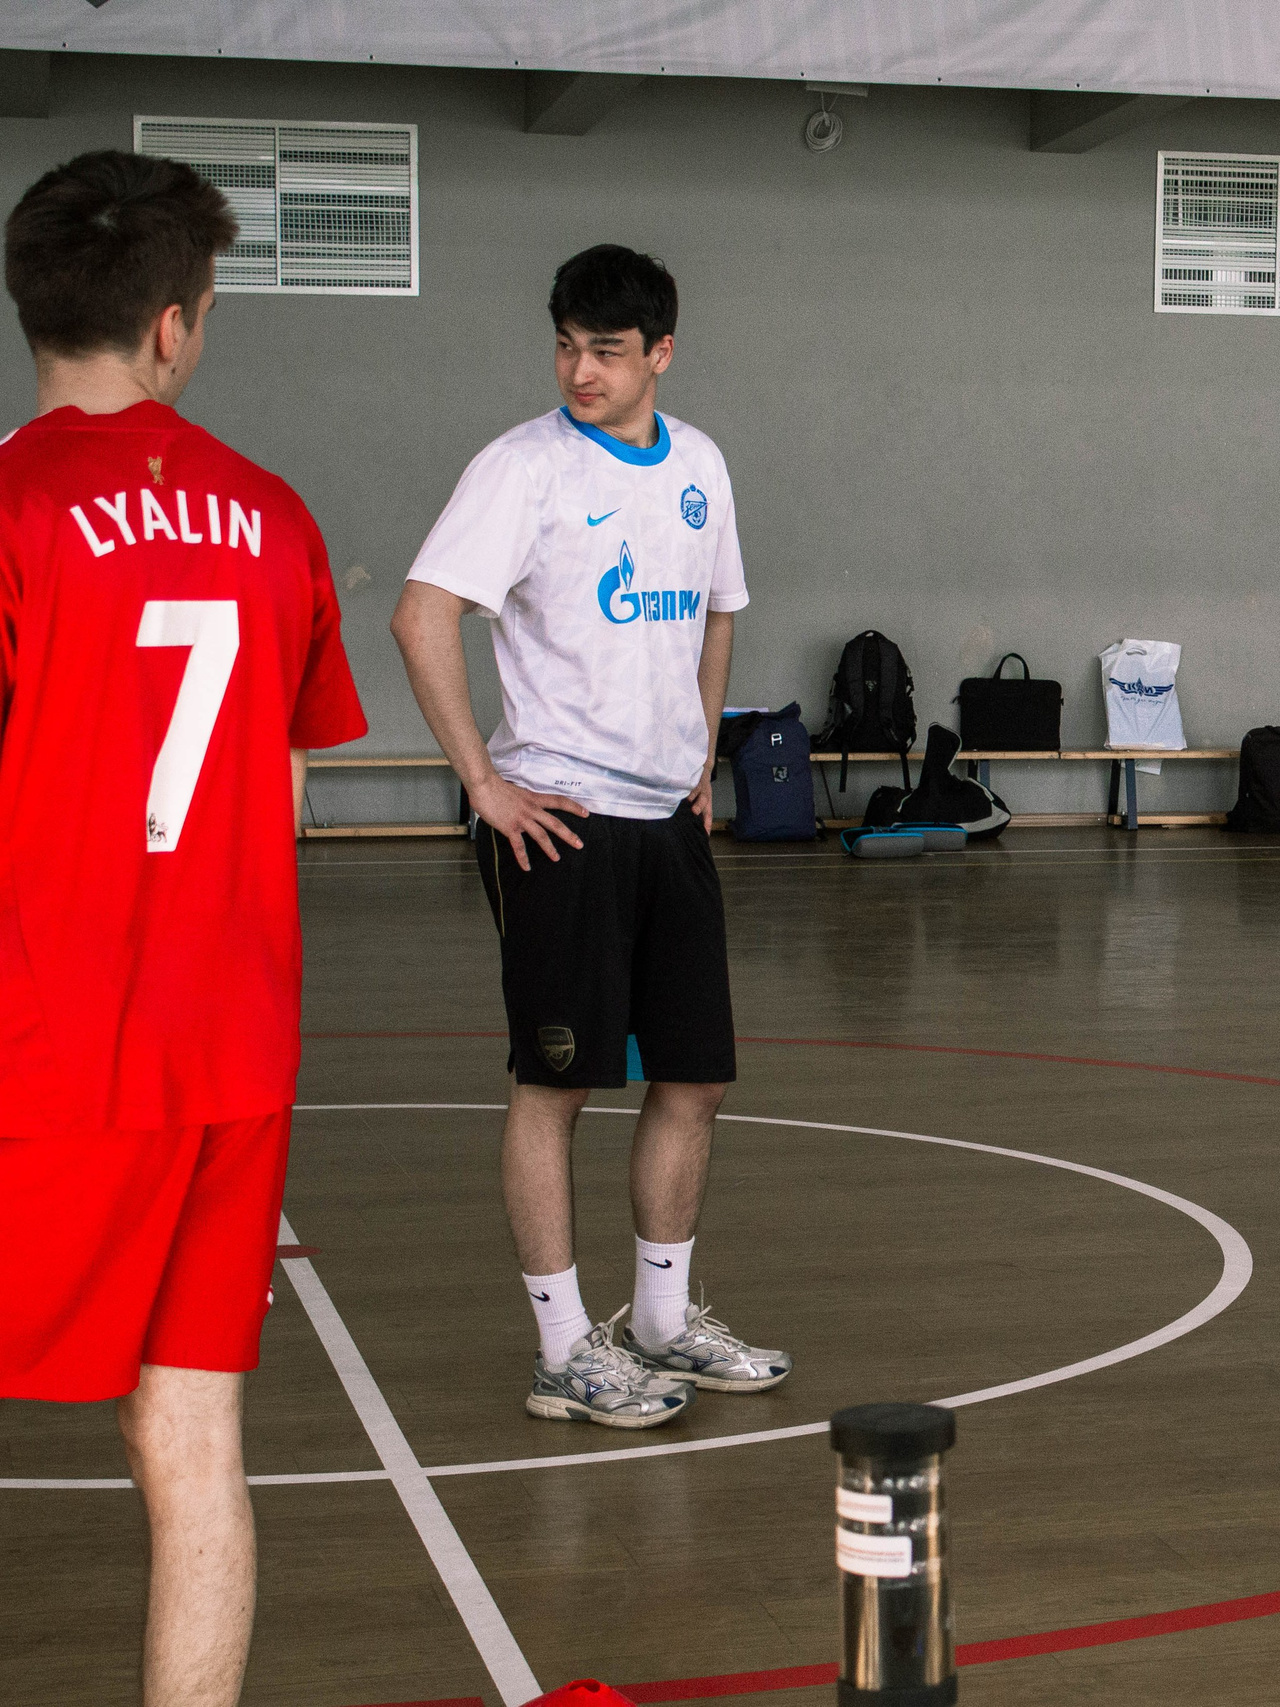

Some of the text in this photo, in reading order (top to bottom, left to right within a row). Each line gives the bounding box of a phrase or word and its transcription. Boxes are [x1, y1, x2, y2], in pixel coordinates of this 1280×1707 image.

[69, 488, 262, 558] LYALIN
[136, 599, 240, 853] 7
[554, 779, 582, 787] DRI-FIT
